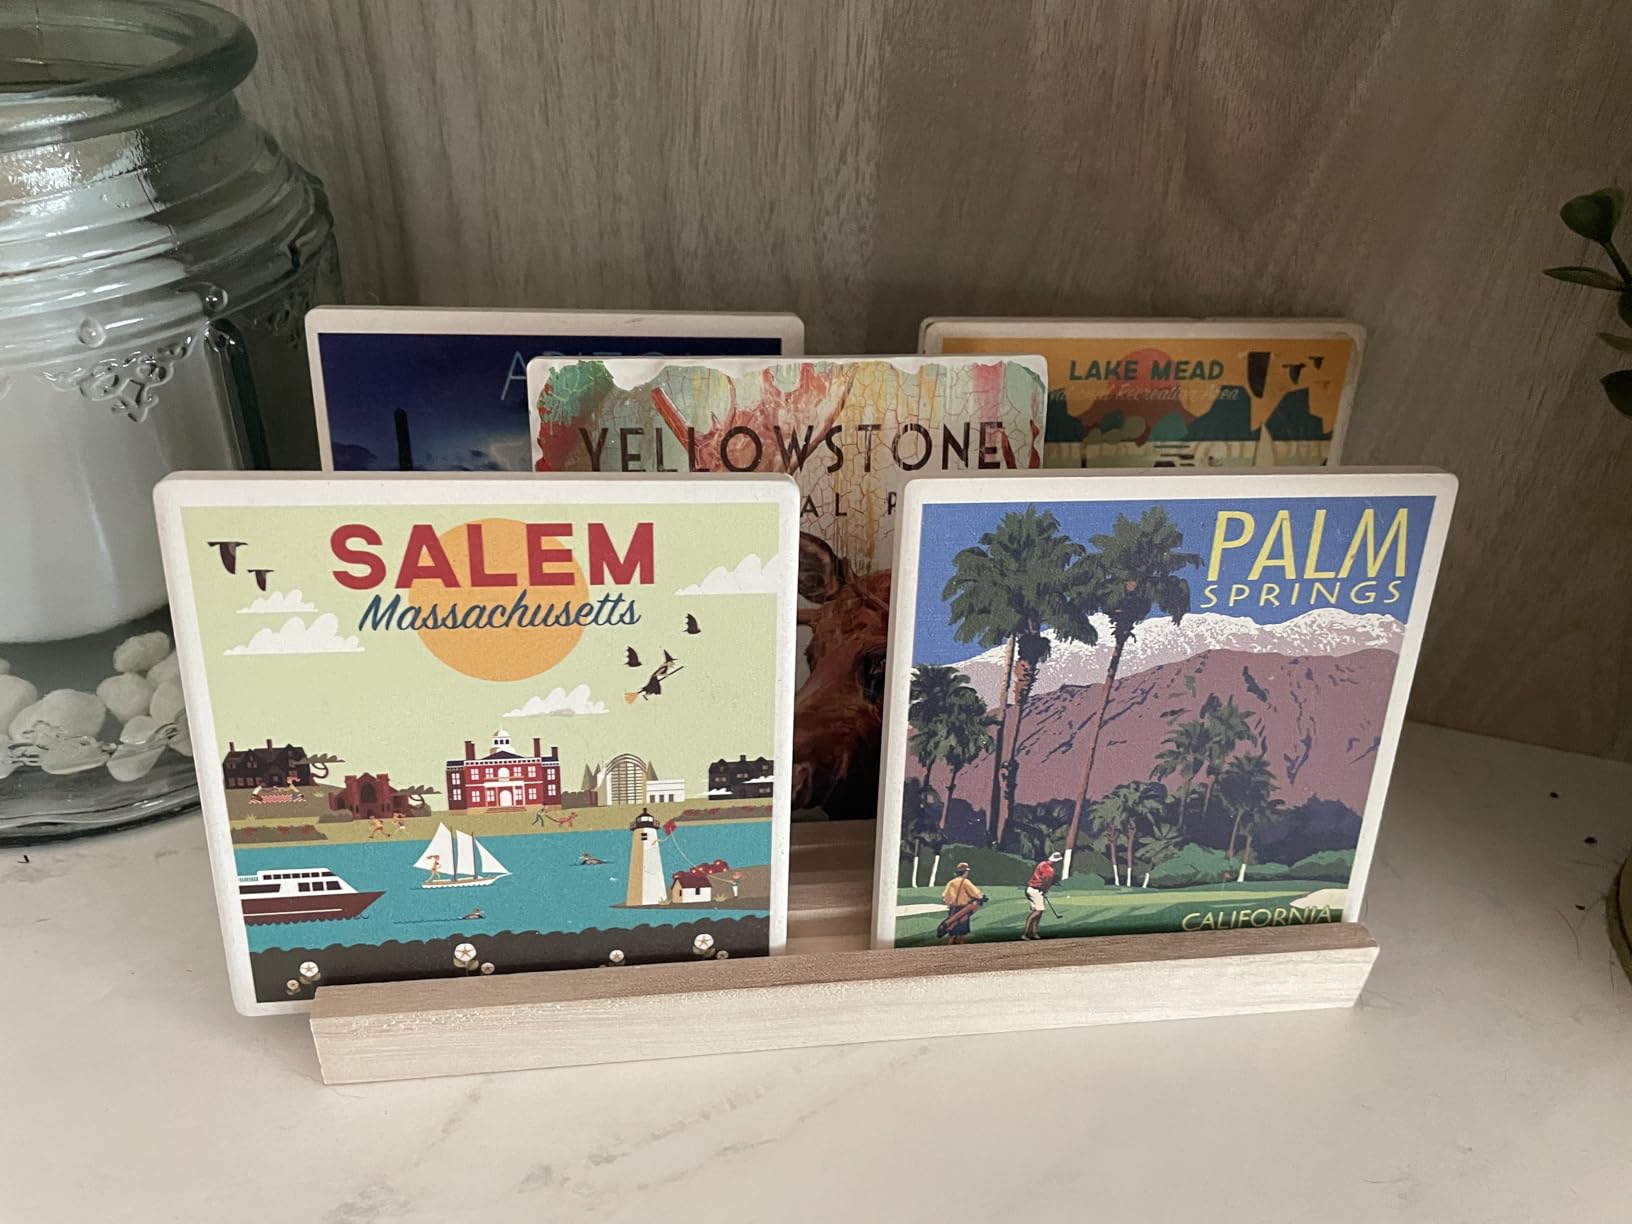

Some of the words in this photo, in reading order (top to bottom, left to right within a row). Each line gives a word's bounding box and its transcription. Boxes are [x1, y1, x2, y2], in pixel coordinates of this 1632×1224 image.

[1069, 359, 1138, 381] LAKE
[1150, 359, 1225, 381] MEAD
[578, 421, 1003, 474] YELLOWSTONE
[330, 521, 655, 590] SALEM
[1207, 507, 1408, 582] PALM
[358, 588, 642, 632] Massachusetts
[1200, 580, 1402, 608] SPRINGS
[1182, 904, 1332, 932] CALIFORNIA
